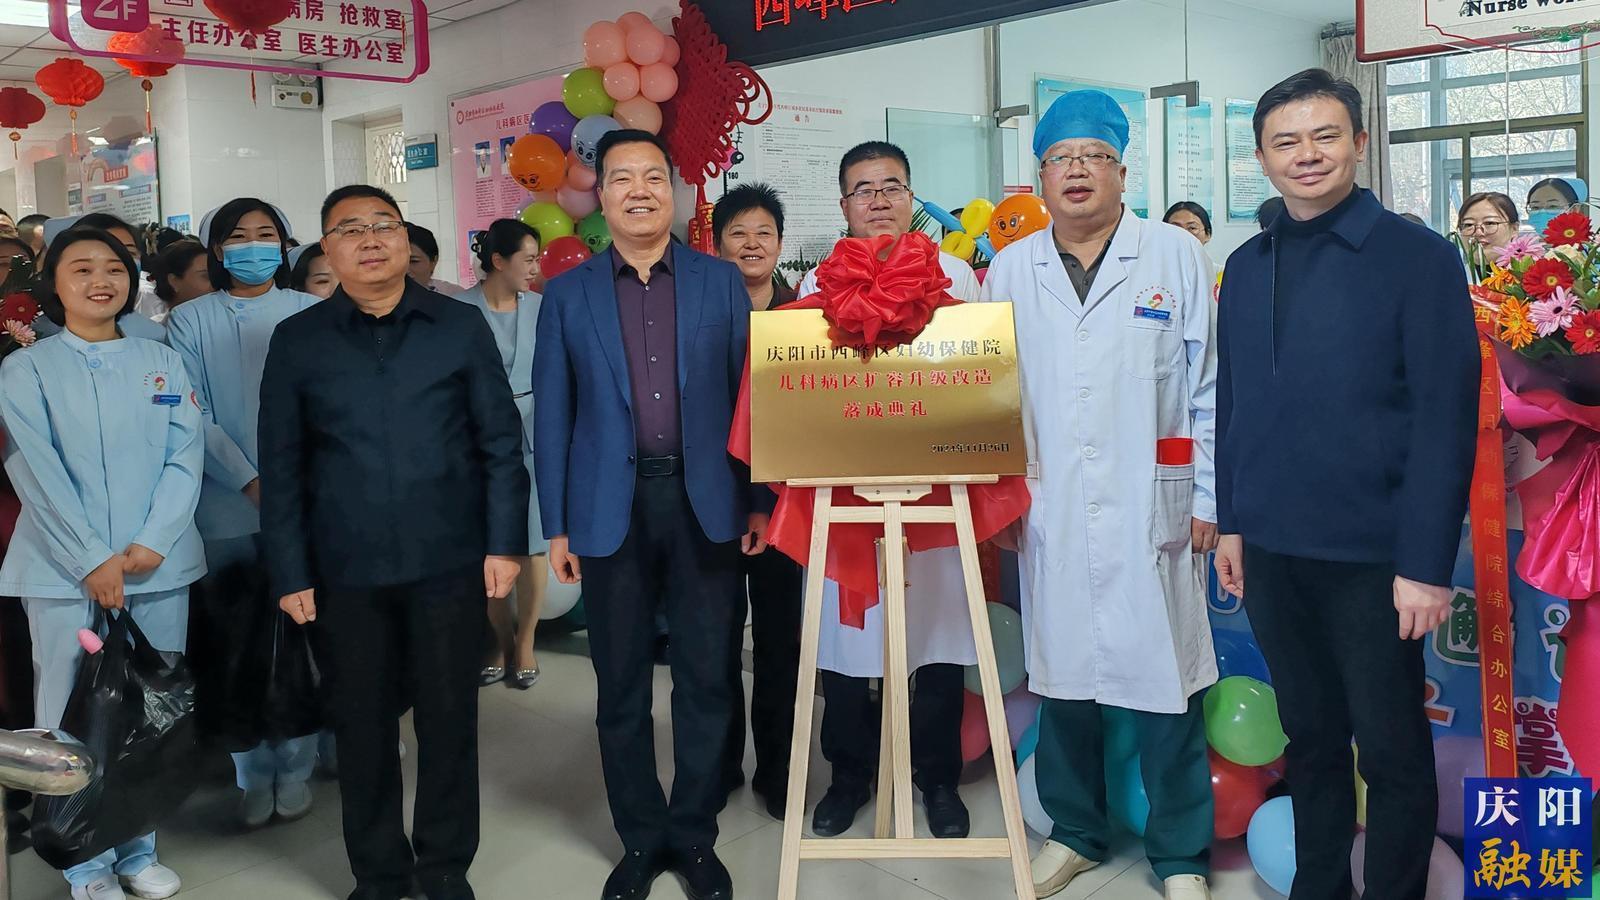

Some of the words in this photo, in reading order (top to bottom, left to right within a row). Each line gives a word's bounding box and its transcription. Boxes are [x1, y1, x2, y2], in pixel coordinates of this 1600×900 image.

[340, 3, 402, 31] 抢救室
[1466, 0, 1528, 17] Nurse
[299, 33, 404, 64] 医生办公室
[766, 339, 1001, 363] 庆阳市西峰区妇幼保健院
[778, 367, 993, 392] 儿科病区扩容升级改造
[843, 399, 929, 419] 落成典礼
[931, 442, 1010, 454] 2024年11月26日
